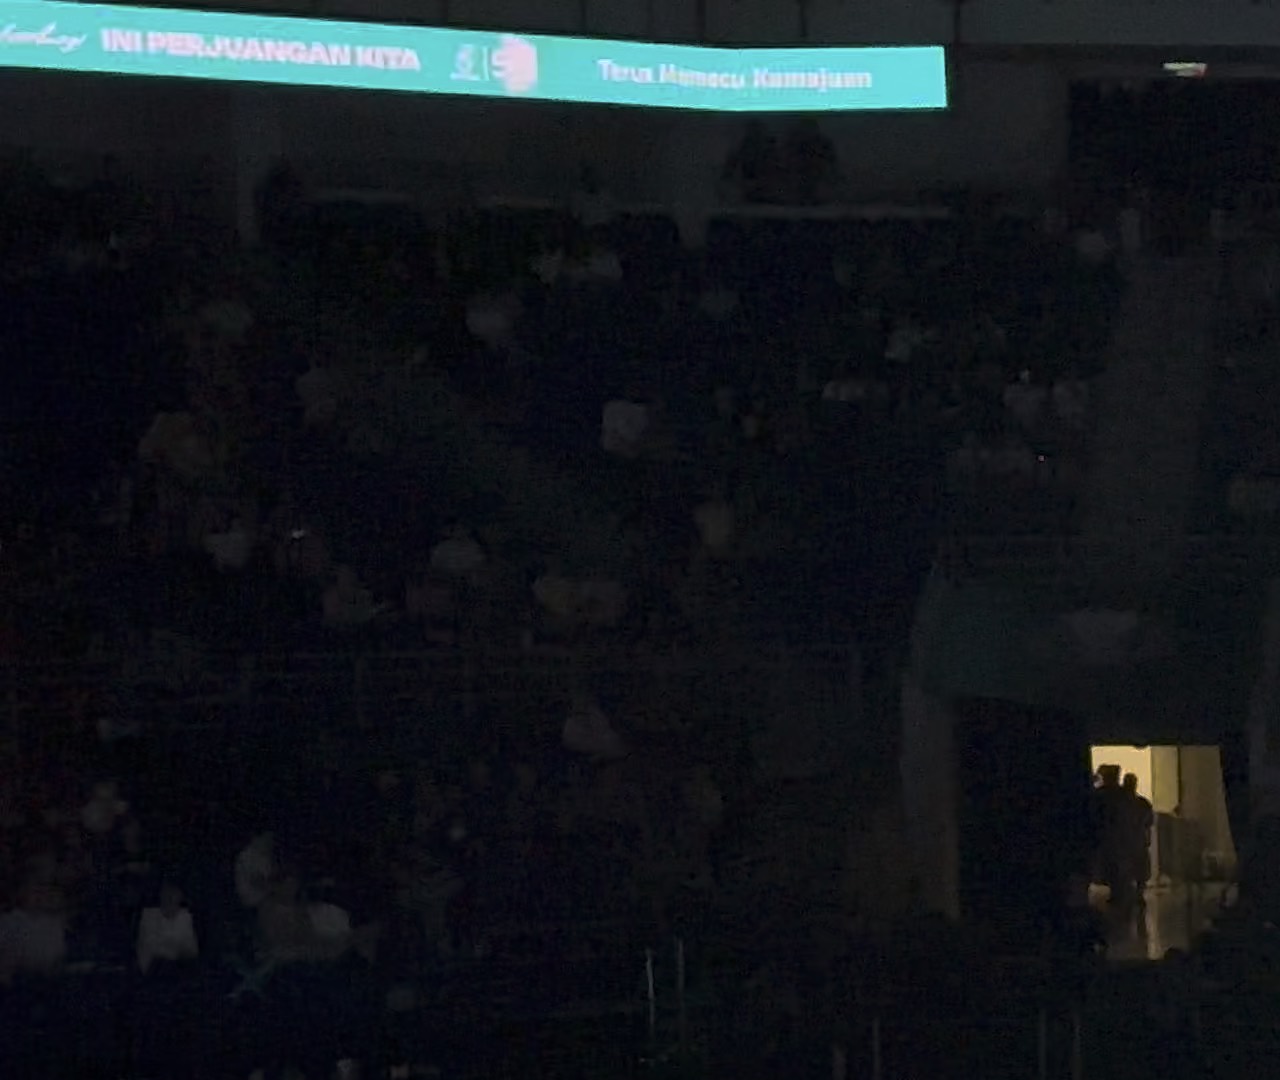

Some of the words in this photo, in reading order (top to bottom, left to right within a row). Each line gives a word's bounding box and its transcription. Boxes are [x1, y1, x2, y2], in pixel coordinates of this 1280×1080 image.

[101, 28, 142, 53] INI
[147, 32, 352, 66] PERJUANGAN
[356, 46, 421, 71] KITA
